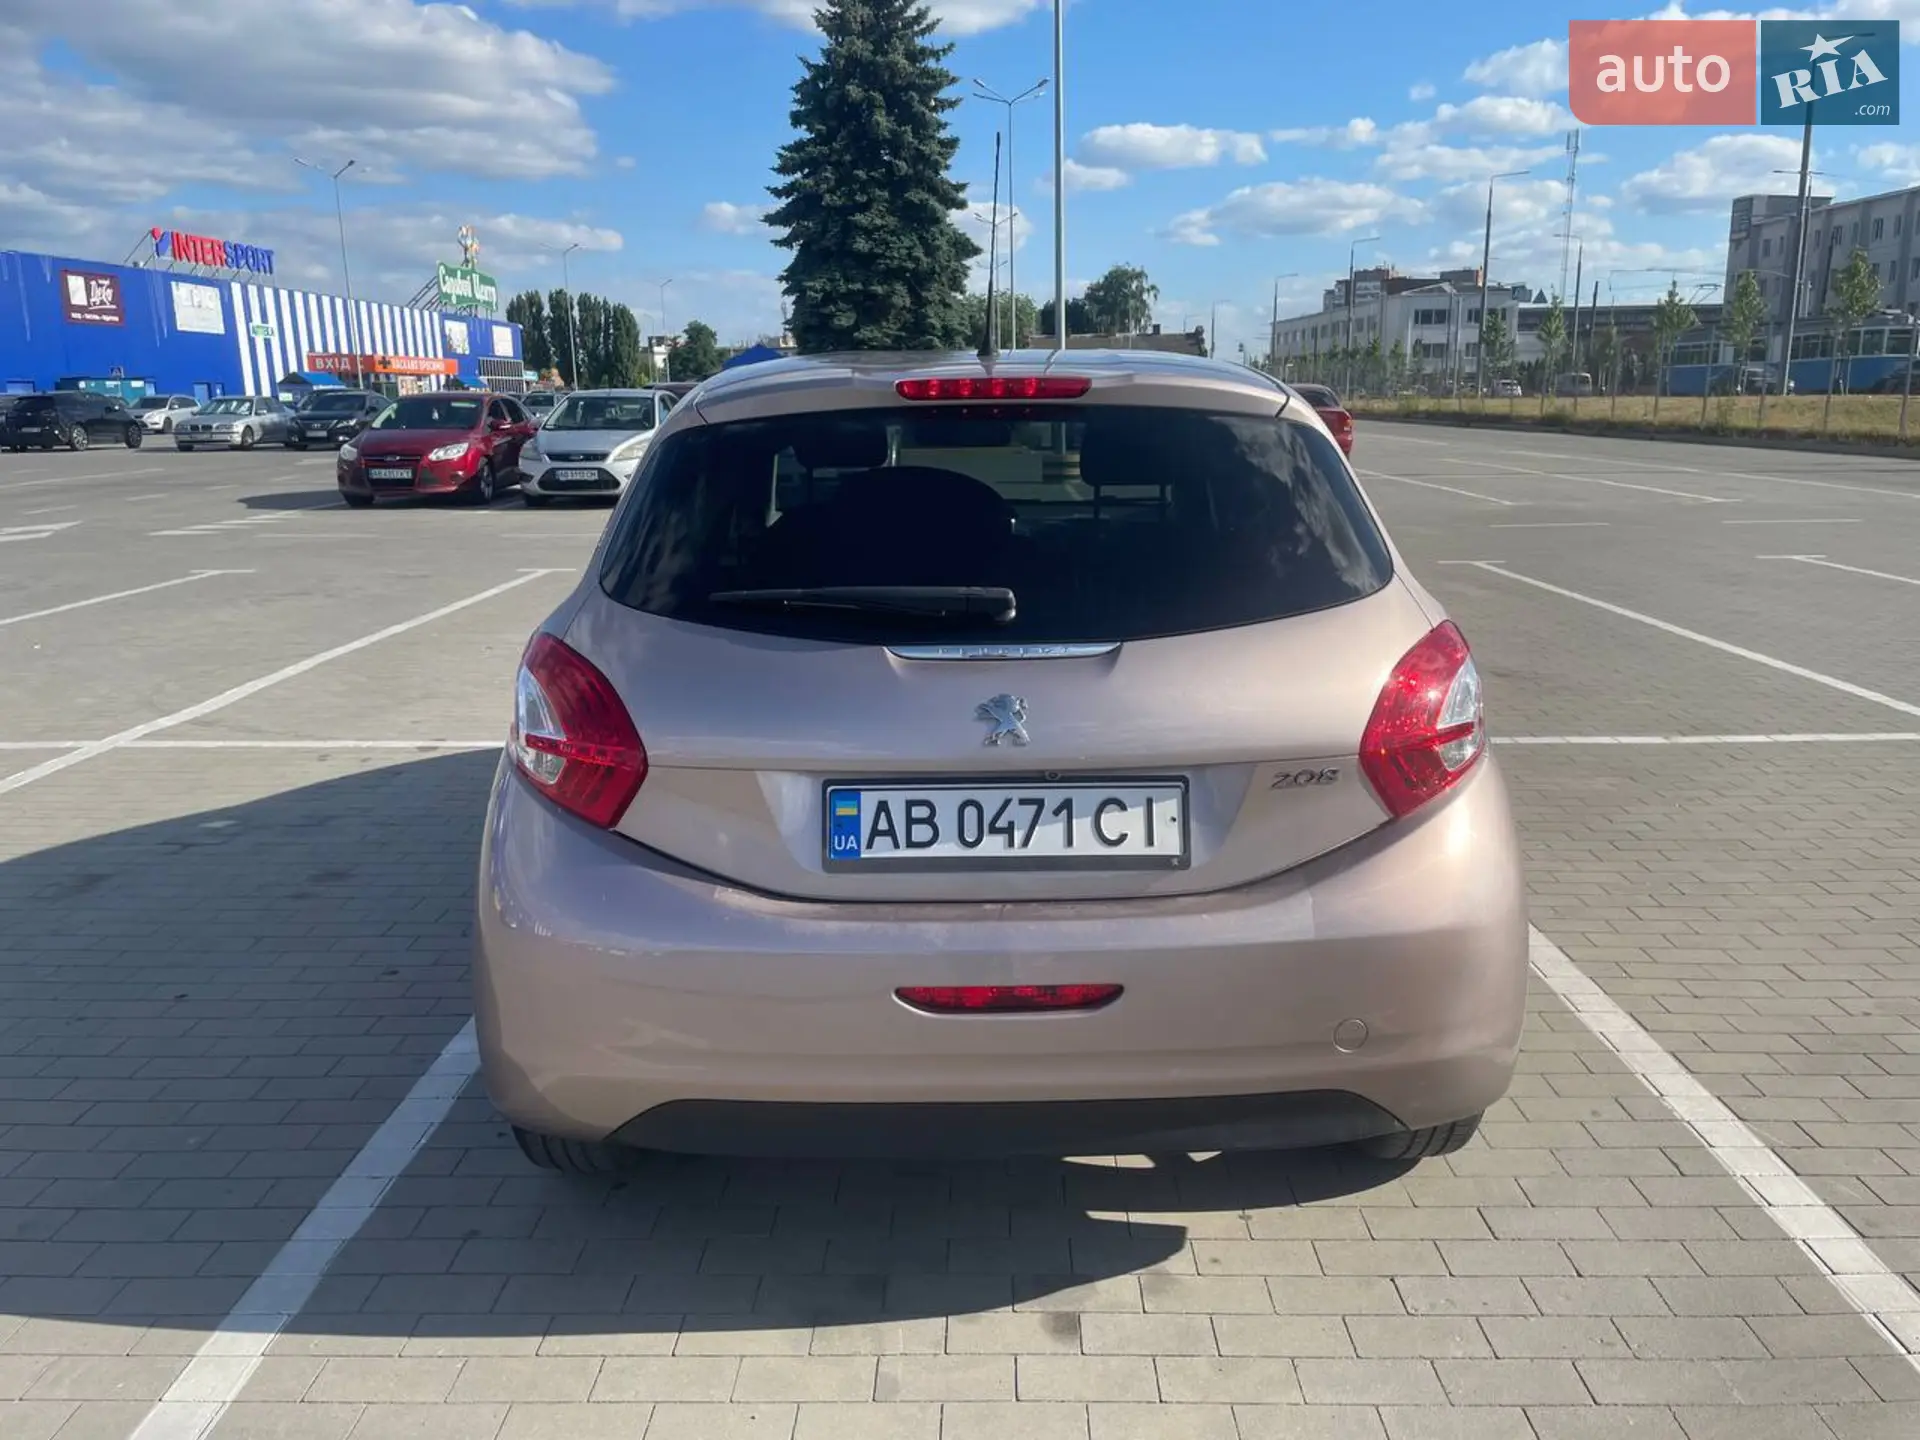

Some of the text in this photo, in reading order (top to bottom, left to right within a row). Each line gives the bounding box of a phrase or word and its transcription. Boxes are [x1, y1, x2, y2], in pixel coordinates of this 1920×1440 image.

[171, 231, 274, 275] INTERSPORT
[315, 356, 351, 371] ВХІД
[865, 797, 1155, 850] AB 0471 CI
[834, 835, 858, 851] UA
